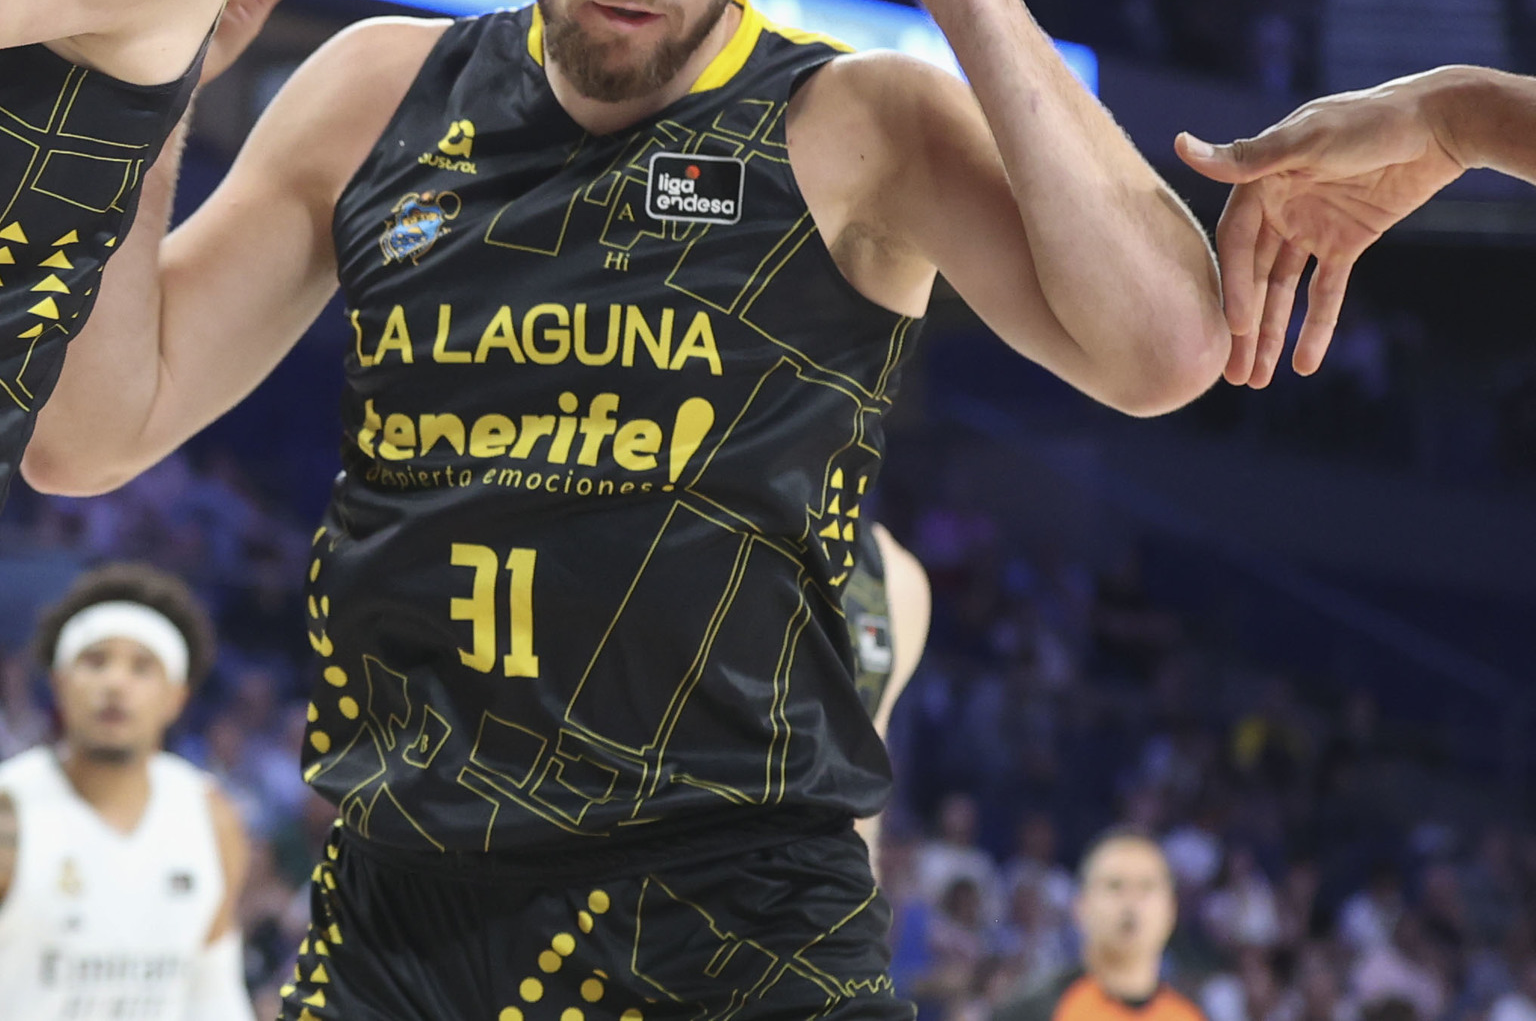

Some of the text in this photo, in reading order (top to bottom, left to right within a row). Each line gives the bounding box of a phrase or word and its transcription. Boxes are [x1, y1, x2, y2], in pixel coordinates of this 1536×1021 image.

[658, 173, 695, 196] liga
[656, 193, 735, 215] endesa
[351, 303, 723, 375] LA LAGUNA
[482, 468, 653, 496] emociones
[450, 543, 539, 678] 31
